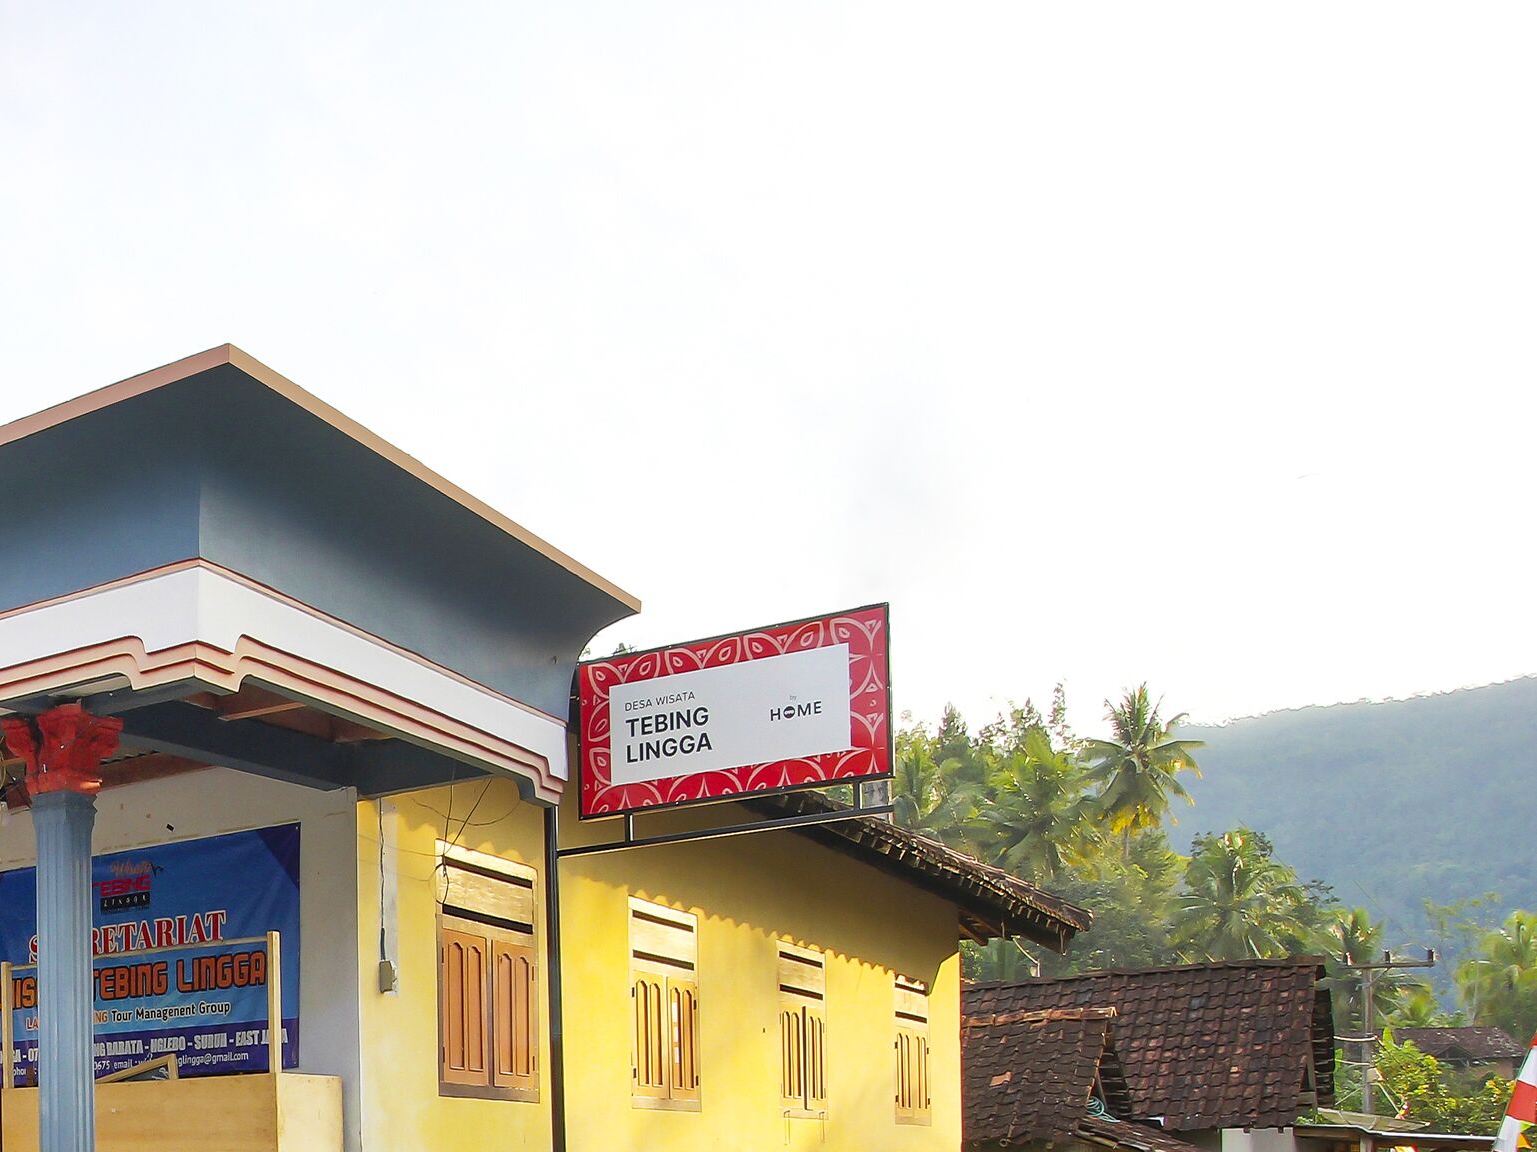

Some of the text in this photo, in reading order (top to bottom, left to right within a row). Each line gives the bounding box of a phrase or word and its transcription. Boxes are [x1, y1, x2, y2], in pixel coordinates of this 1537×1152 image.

[625, 692, 695, 711] DESA WISATA
[626, 706, 709, 737] TEBING
[626, 733, 712, 763] LINGGA
[176, 951, 267, 993] LINGGA
[111, 1010, 132, 1022] Tour
[199, 1001, 231, 1015] Group
[106, 1040, 143, 1056] BARATA
[235, 1030, 259, 1046] EAST
[114, 1059, 133, 1070] email
